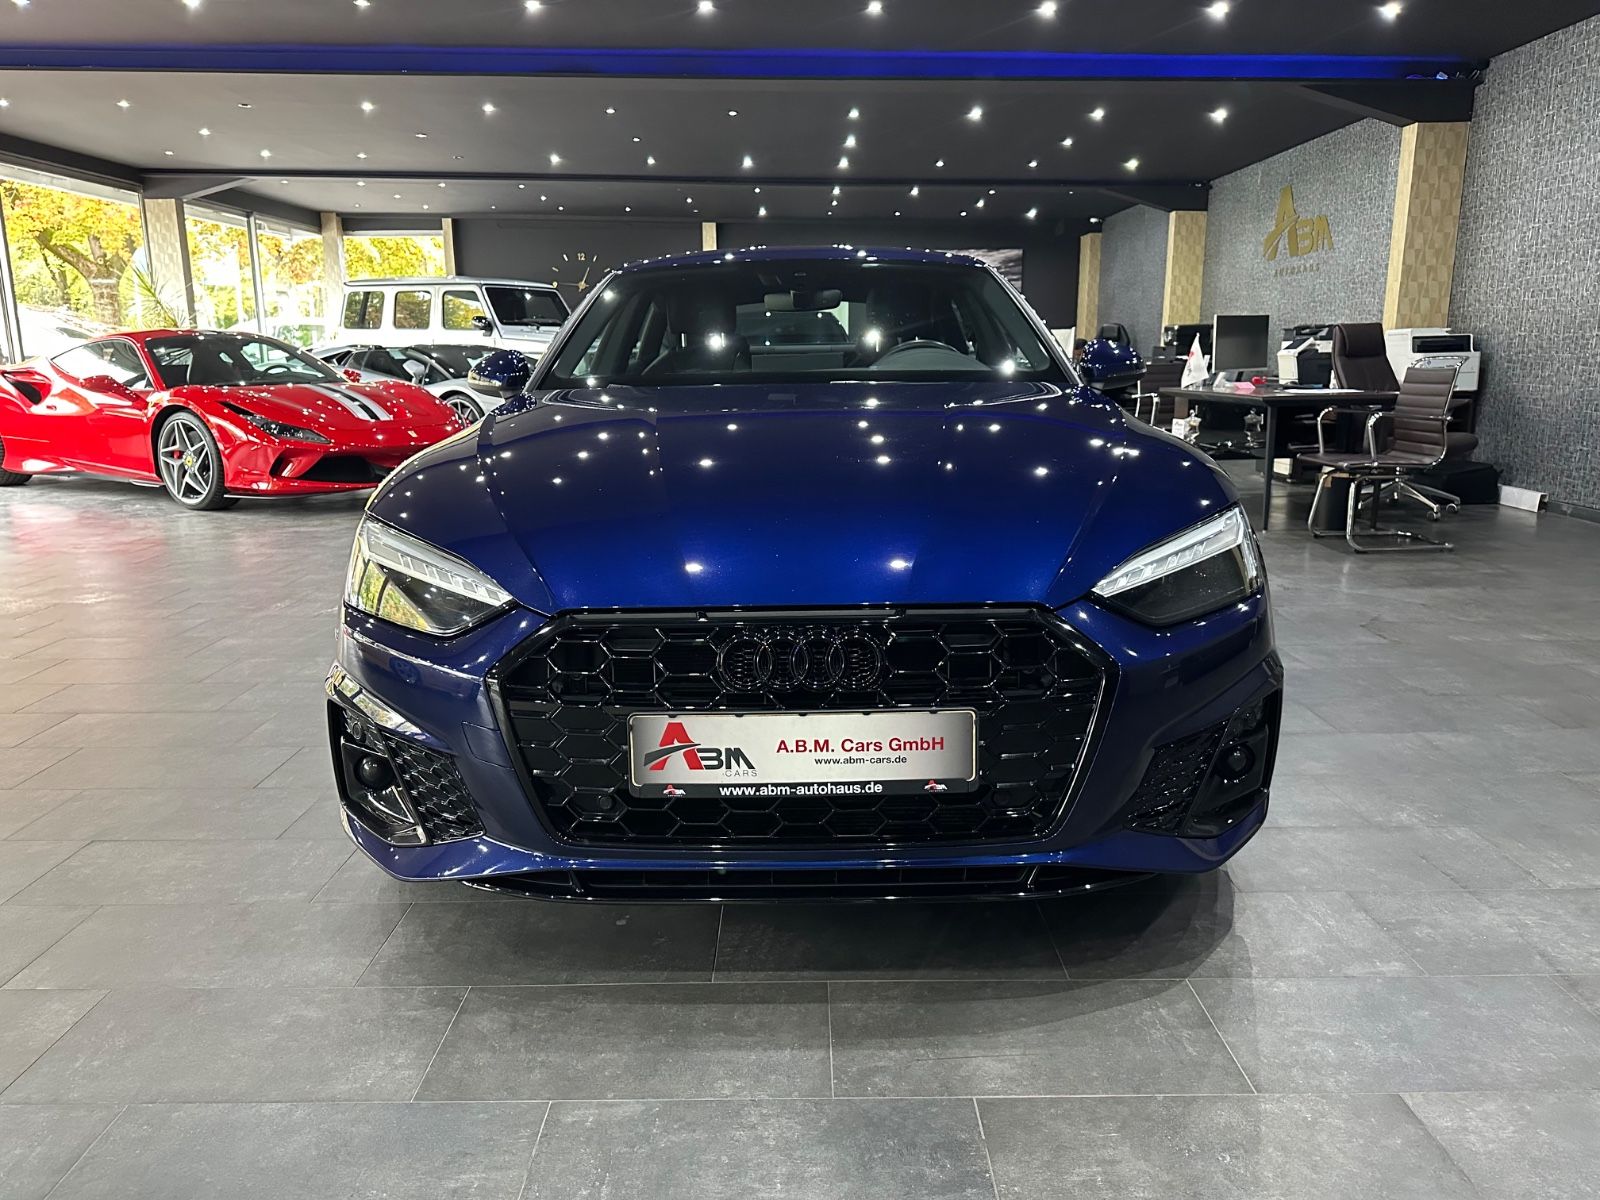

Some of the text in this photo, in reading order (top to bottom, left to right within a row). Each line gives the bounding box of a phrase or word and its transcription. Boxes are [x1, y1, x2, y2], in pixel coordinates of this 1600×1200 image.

[1263, 183, 1334, 261] ABM
[577, 252, 585, 260] 12
[644, 722, 755, 770] ABM
[776, 737, 944, 753] A.B.M. Cars GmbH
[814, 755, 907, 765] www.abm-cars.de
[719, 782, 882, 795] www.abm-autohaus.de
